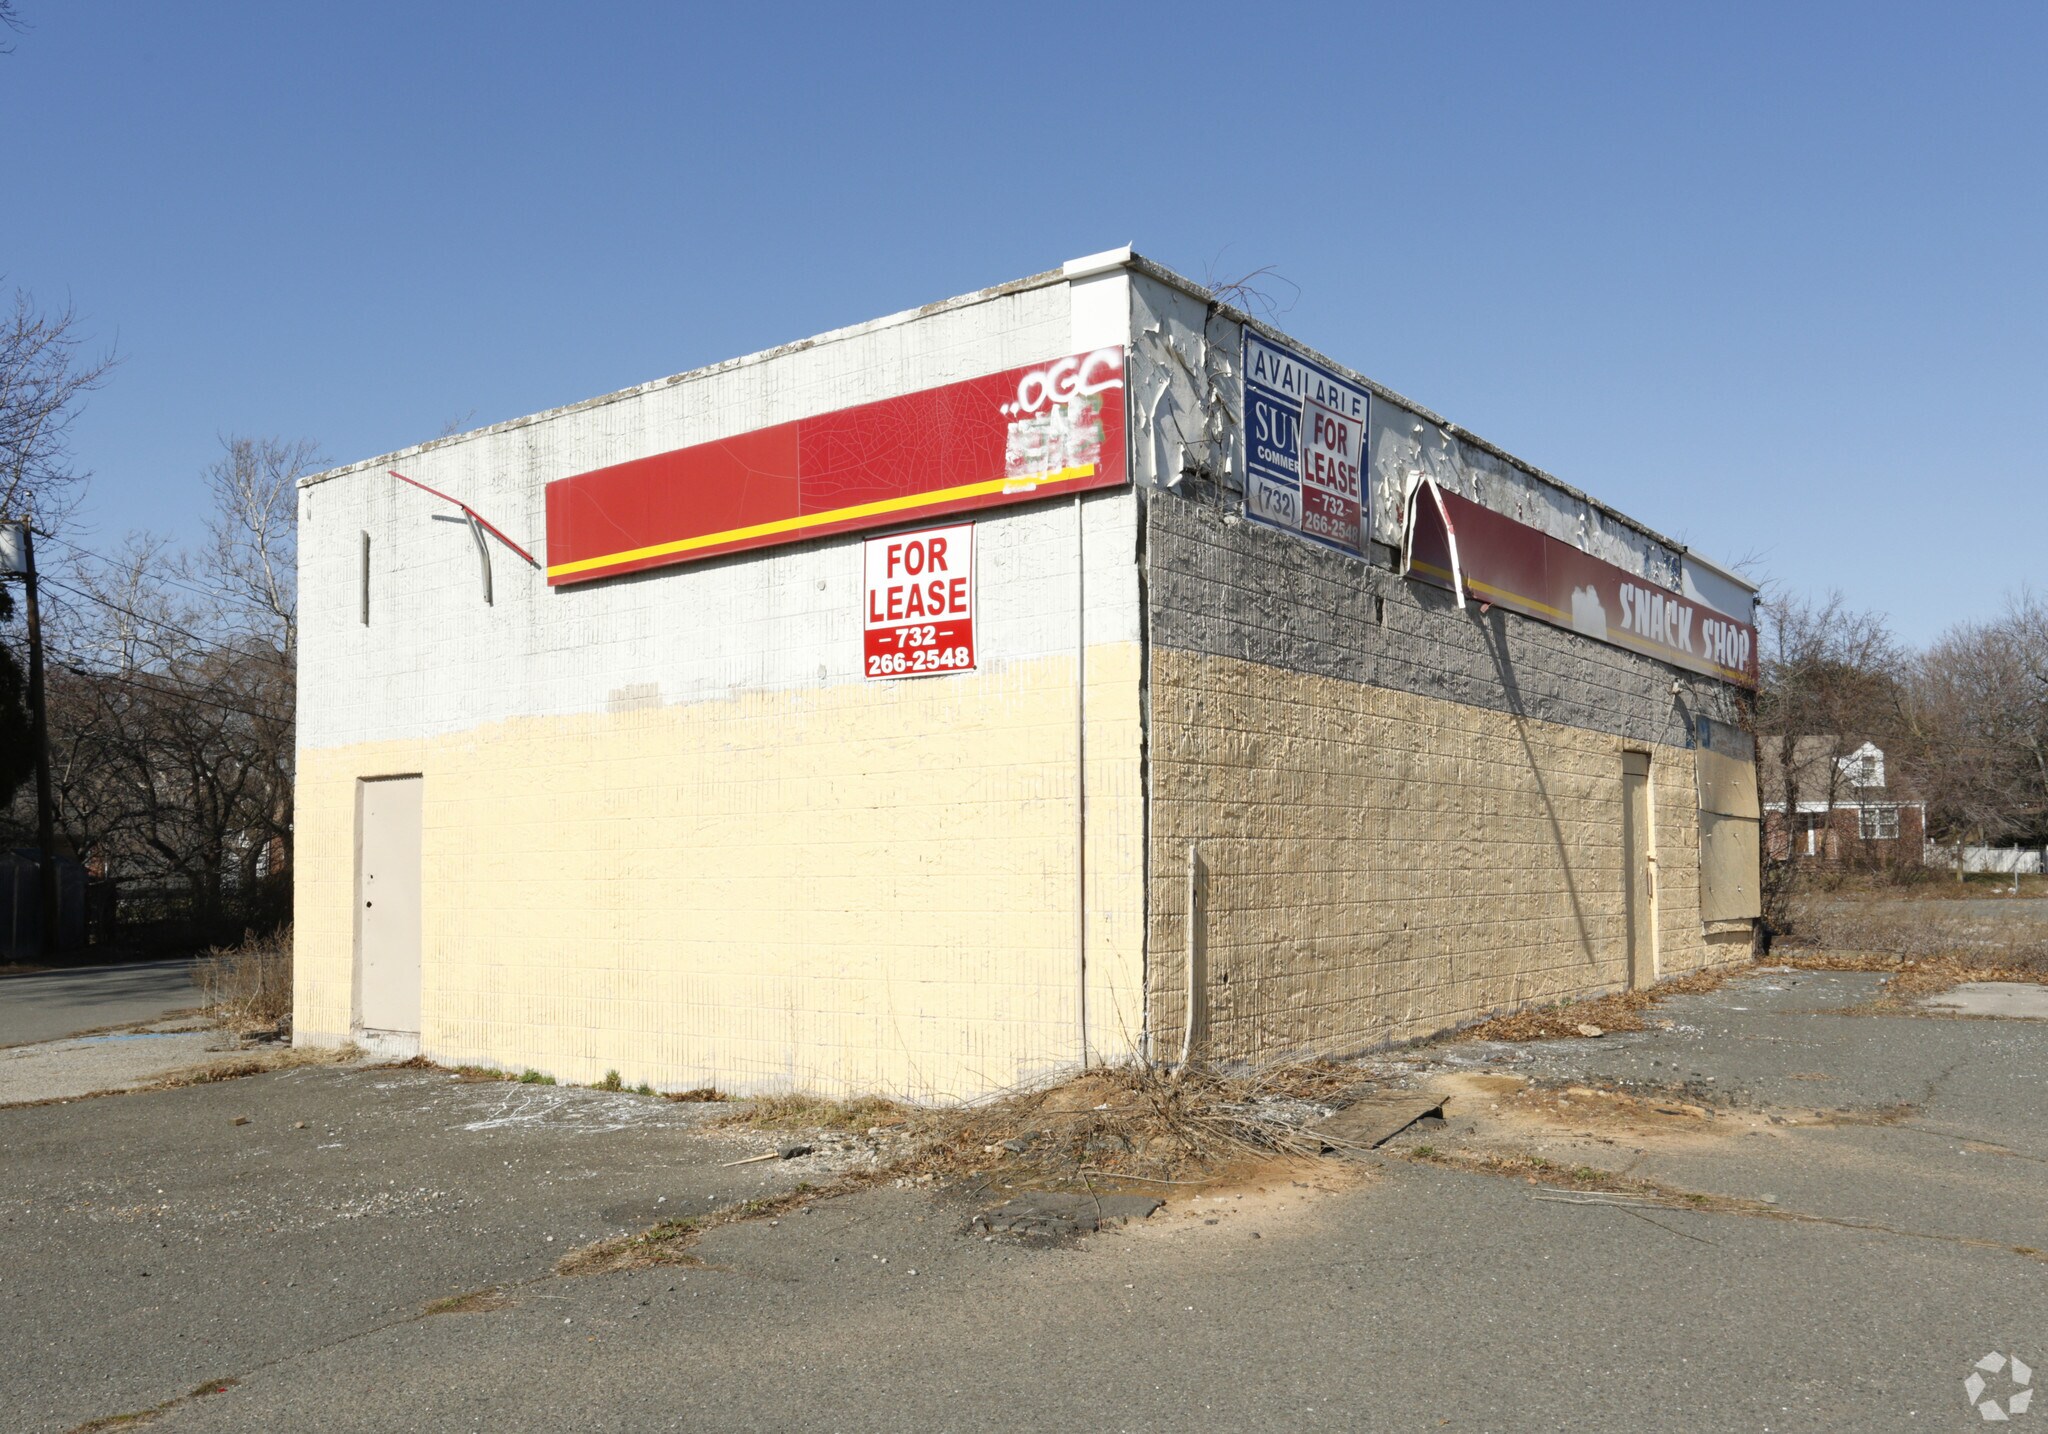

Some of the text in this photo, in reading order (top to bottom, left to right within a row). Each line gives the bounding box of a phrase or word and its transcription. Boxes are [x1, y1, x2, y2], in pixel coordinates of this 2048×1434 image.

[1314, 413, 1348, 456] FOR
[1304, 448, 1358, 497] LEASE
[1259, 482, 1295, 522] (732)
[1305, 512, 1358, 542] 266-2548
[887, 537, 949, 579] FOR
[869, 577, 967, 623] LEASE
[1619, 582, 1750, 671] SNACK SHOP
[868, 647, 970, 675] 266-2548
